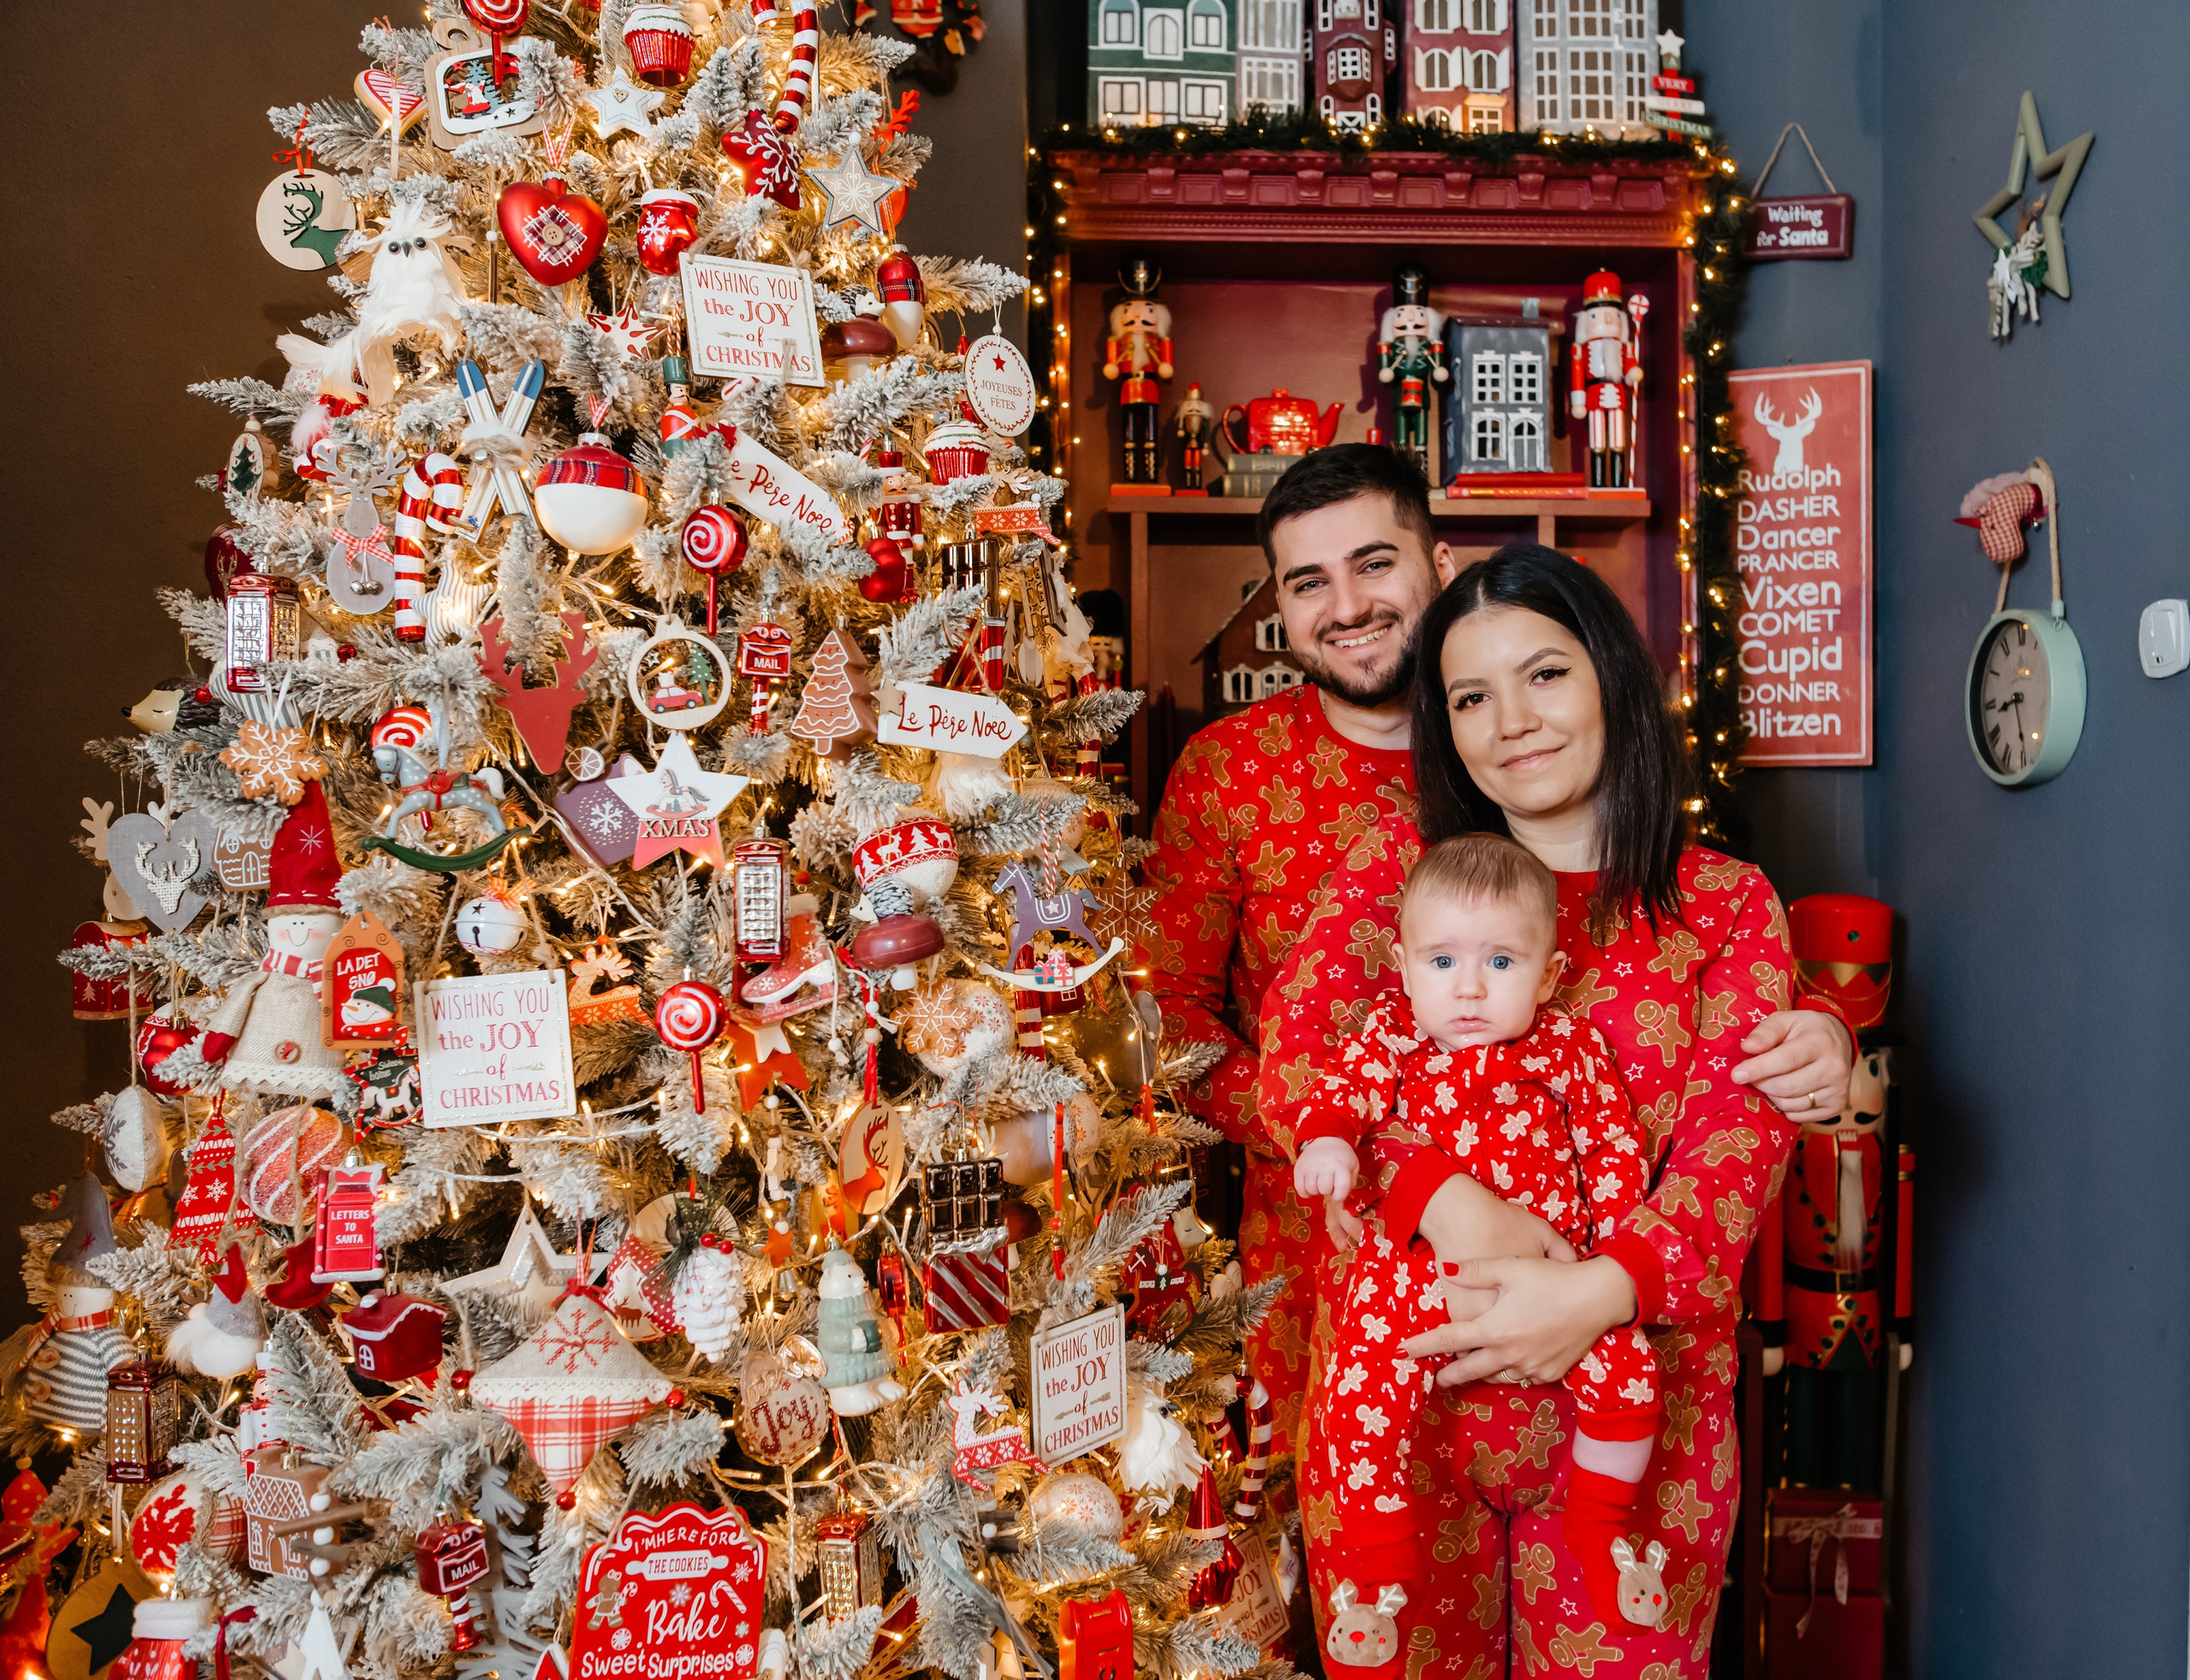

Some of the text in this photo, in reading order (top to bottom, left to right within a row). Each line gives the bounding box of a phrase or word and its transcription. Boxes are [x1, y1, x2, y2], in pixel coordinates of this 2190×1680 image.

[1657, 77, 1689, 91] VERY
[1645, 111, 1711, 137] CHRISTMAS
[1767, 204, 1824, 228] Waiting
[1756, 226, 1829, 247] for Santa
[694, 267, 798, 301] WISHING YOU
[703, 298, 795, 327] the JOY
[746, 326, 765, 348] of
[980, 379, 1023, 397] JOYEUSES
[990, 395, 1016, 411] FÊTES
[749, 464, 791, 506] Père
[1737, 462, 1842, 494] Rudolph
[1737, 494, 1840, 524] DASHER
[1737, 524, 1842, 551] Dancer
[1737, 549, 1840, 574] PRANCER
[1739, 575, 1842, 611] Vixen
[1737, 608, 1841, 637] COMET
[754, 656, 782, 670] MAIL
[1737, 636, 1843, 682] Cupid
[1738, 681, 1841, 704] DONNER
[897, 691, 1013, 741] Le Père Noël
[639, 819, 713, 838] XMAS
[336, 951, 382, 976] LA DET
[348, 971, 376, 990] SNØ
[430, 986, 549, 1021] WISHING YOU
[438, 1019, 545, 1052] the JOY
[369, 1069, 392, 1081] home
[377, 1058, 405, 1070] Sweet
[486, 1053, 507, 1081] of
[440, 1080, 560, 1109] CHRISTMAS
[330, 1210, 370, 1221] LETTERS
[344, 1222, 357, 1232] TO
[335, 1233, 364, 1245] SANTA
[1041, 1322, 1116, 1372] WISHING YOU
[1045, 1352, 1112, 1399] the JOY
[1074, 1390, 1088, 1416] of
[750, 1395, 819, 1456] Joy
[1045, 1405, 1119, 1453] CHRISTMAS
[699, 1529, 728, 1547] FOR
[1240, 1539, 1261, 1565] YOU
[451, 1559, 480, 1581] MAIL
[648, 1556, 709, 1575] THE COOKIES
[1236, 1564, 1264, 1603] JOY
[644, 1591, 728, 1645] Bake
[1244, 1598, 1255, 1620] of
[1240, 1606, 1281, 1643] RISTMAS
[581, 1647, 735, 1680] Sweet Surprises
